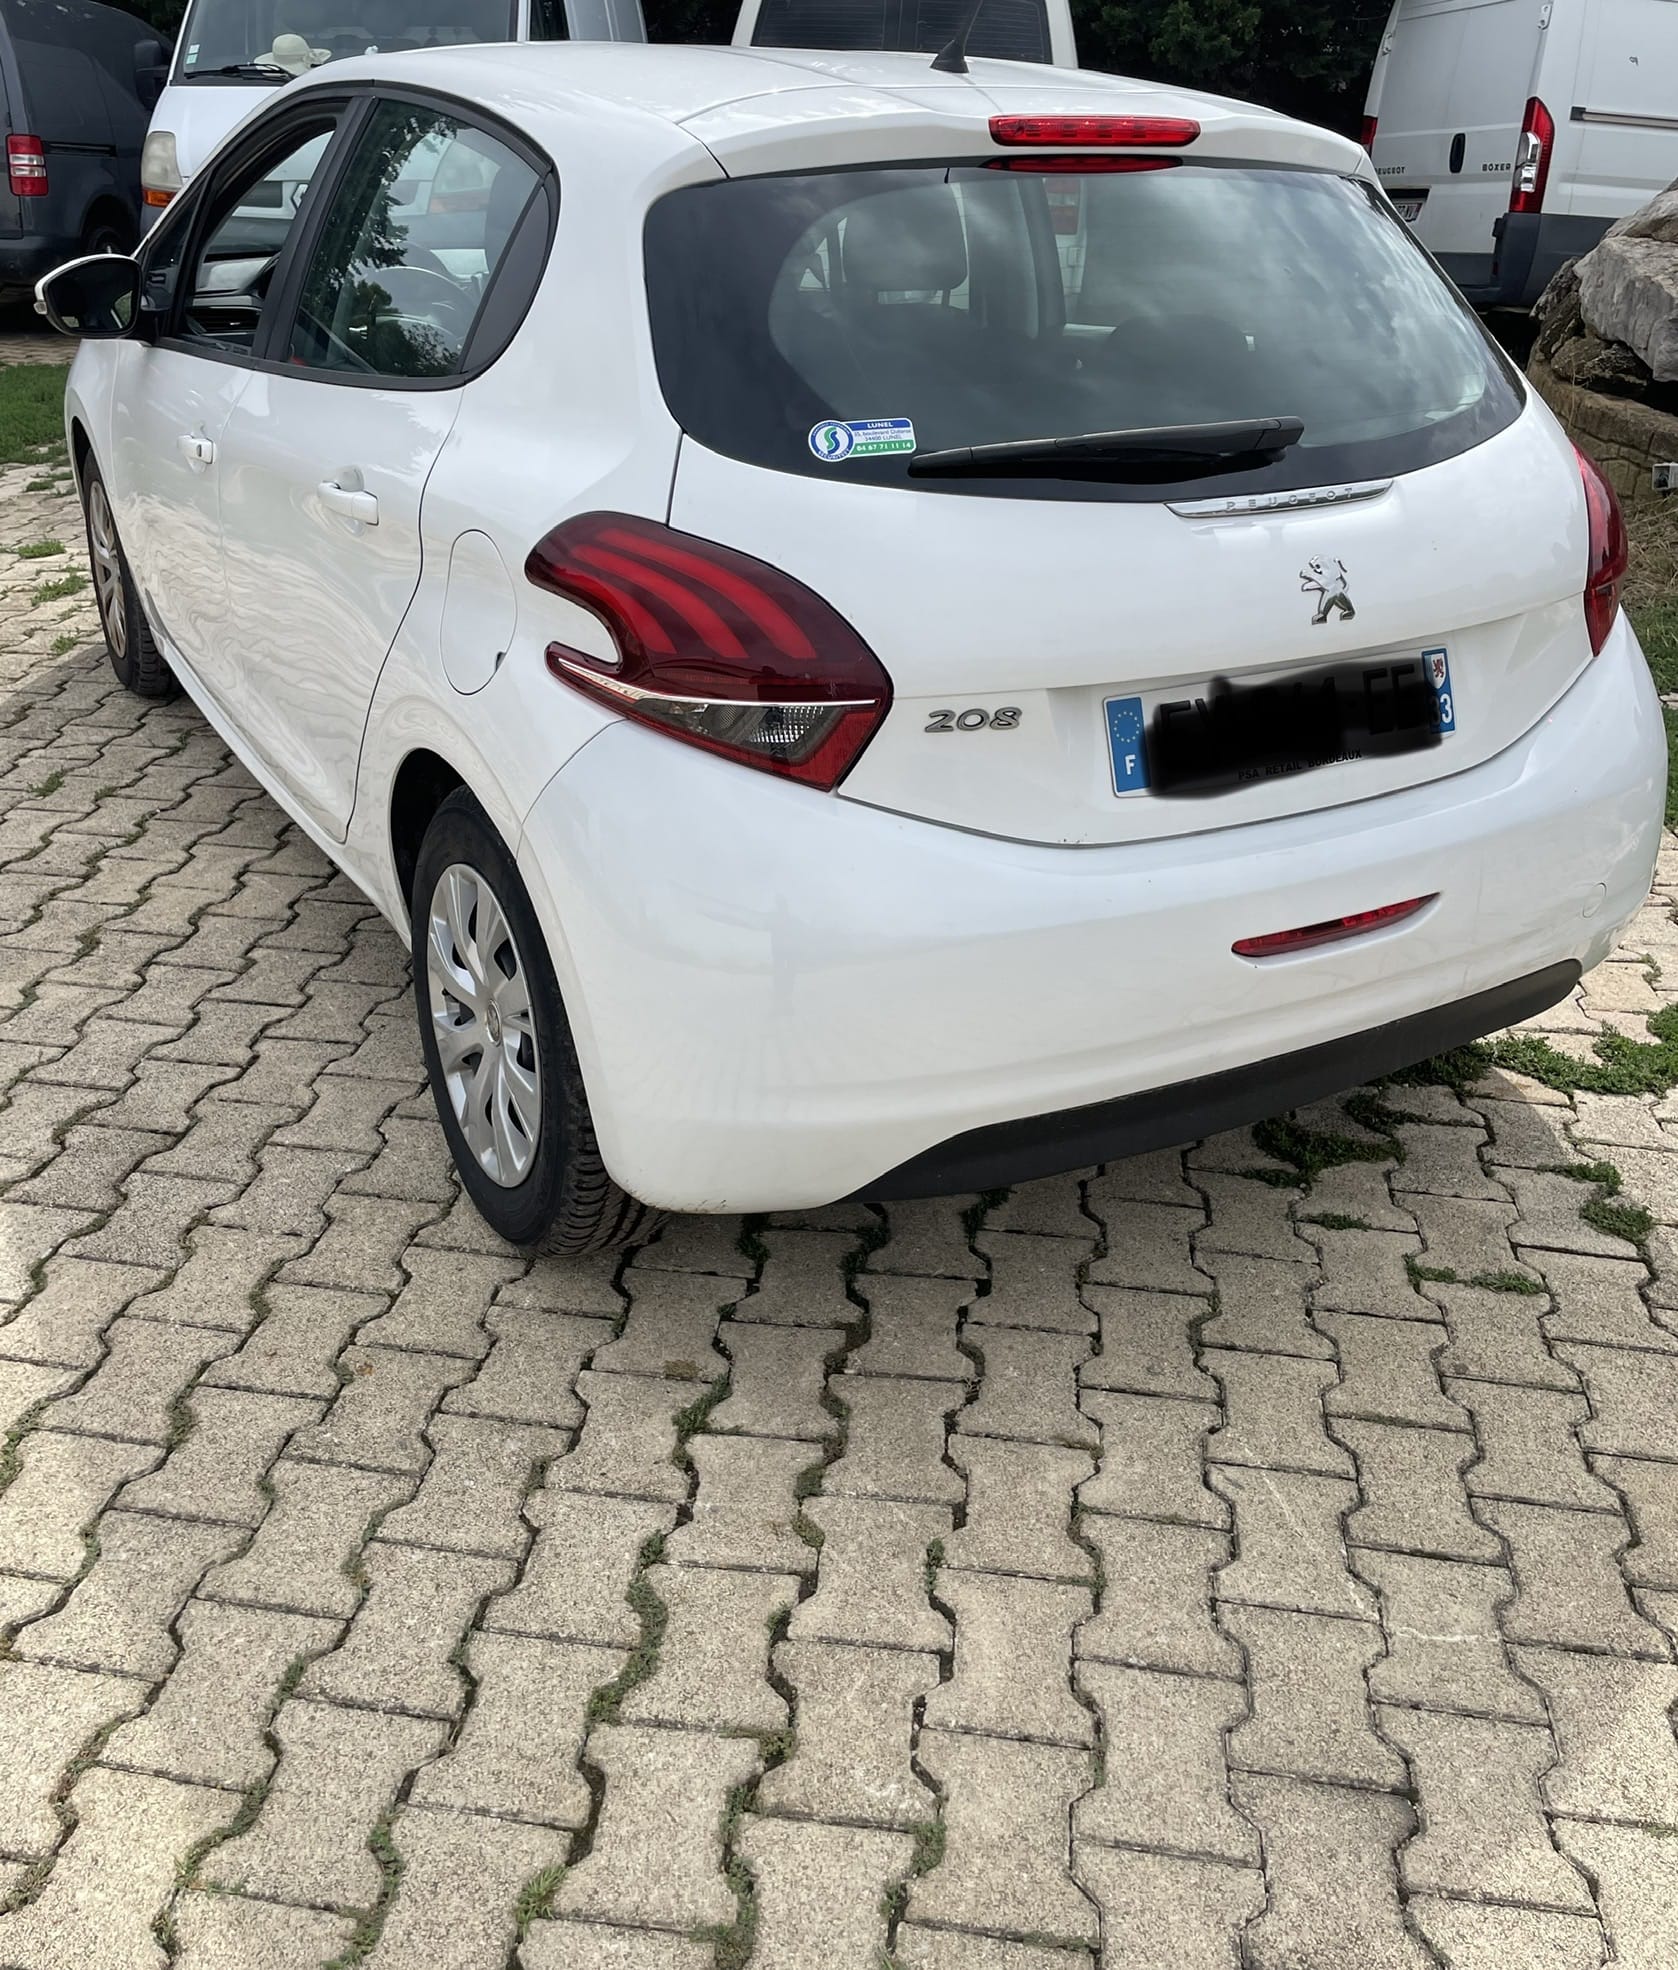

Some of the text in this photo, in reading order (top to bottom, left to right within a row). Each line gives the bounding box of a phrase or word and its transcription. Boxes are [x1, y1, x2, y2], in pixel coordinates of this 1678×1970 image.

[1482, 163, 1511, 171] BOXER
[1226, 487, 1353, 511] PEUGEOT
[924, 707, 1022, 733] 208
[1125, 754, 1136, 775] F
[1238, 750, 1362, 780] PSA RETAIL BORDEAUX
